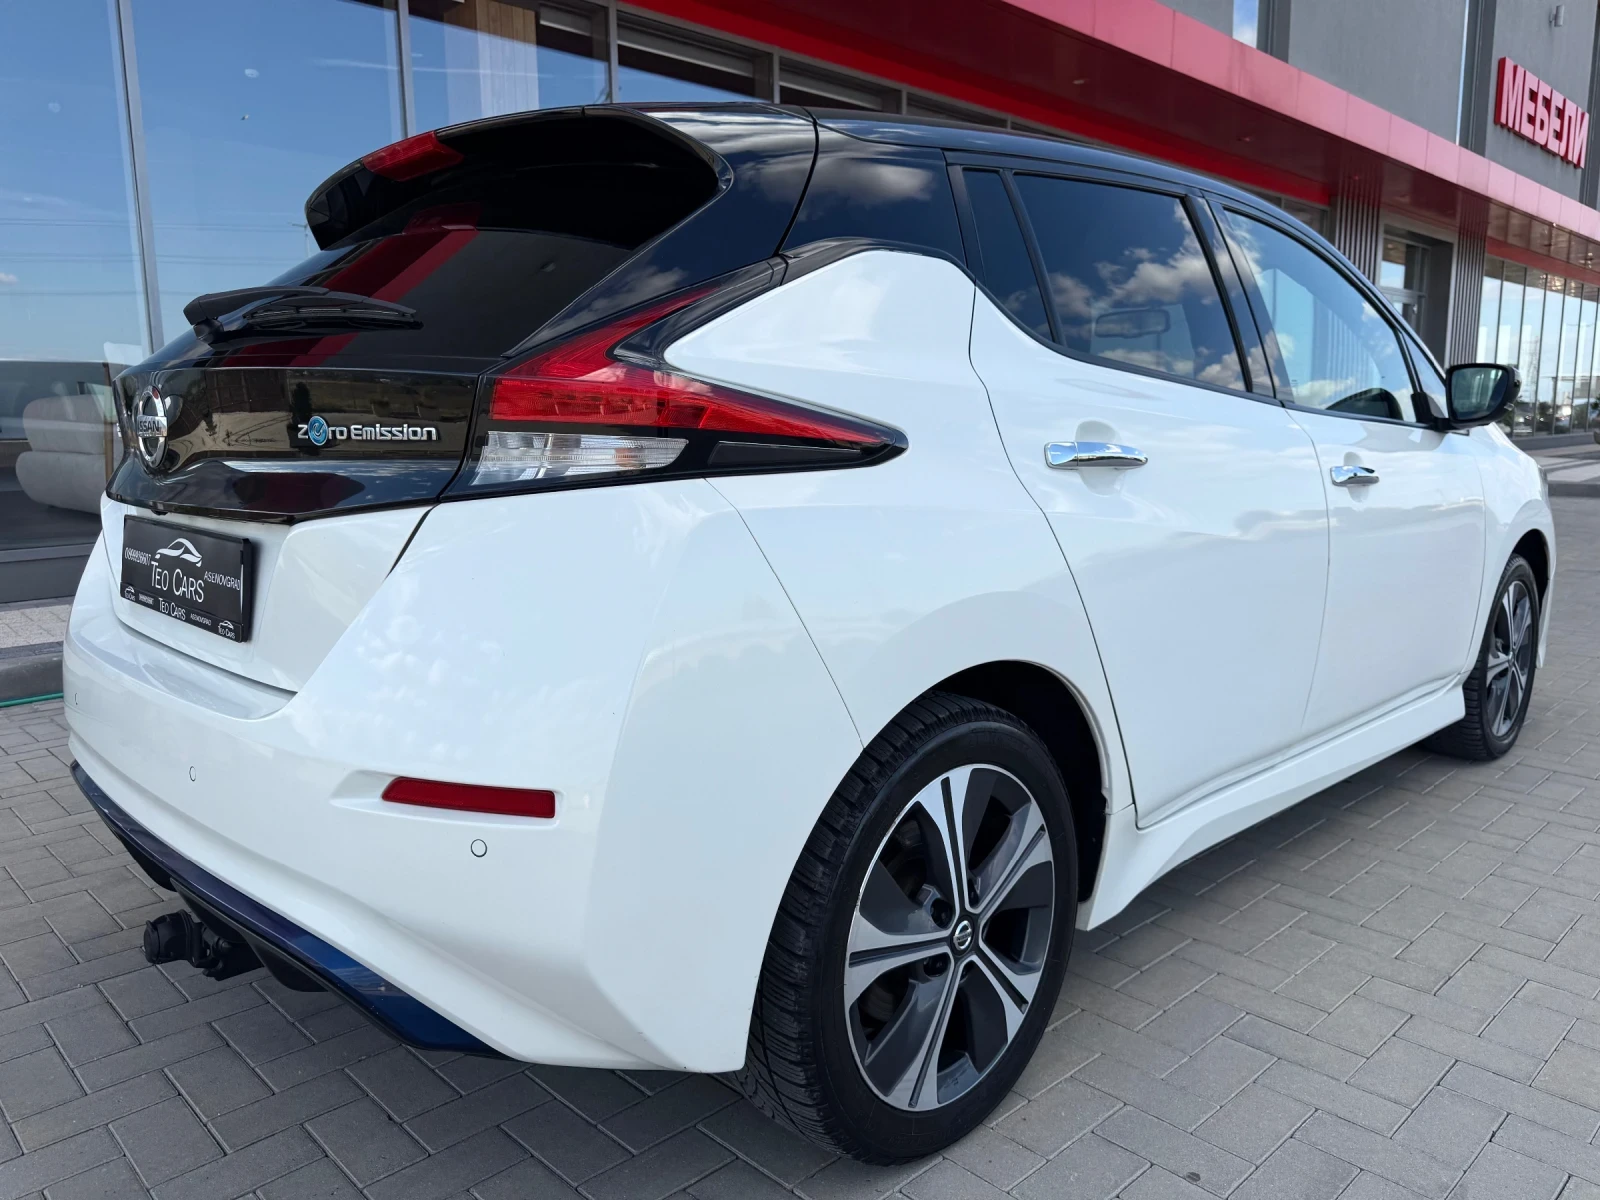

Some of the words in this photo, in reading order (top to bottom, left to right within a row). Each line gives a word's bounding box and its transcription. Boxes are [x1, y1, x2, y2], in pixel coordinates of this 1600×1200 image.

[1497, 56, 1589, 169] МЕБЕЛИ
[350, 423, 438, 441] Emission
[203, 571, 241, 591] ASENOVGRAD
